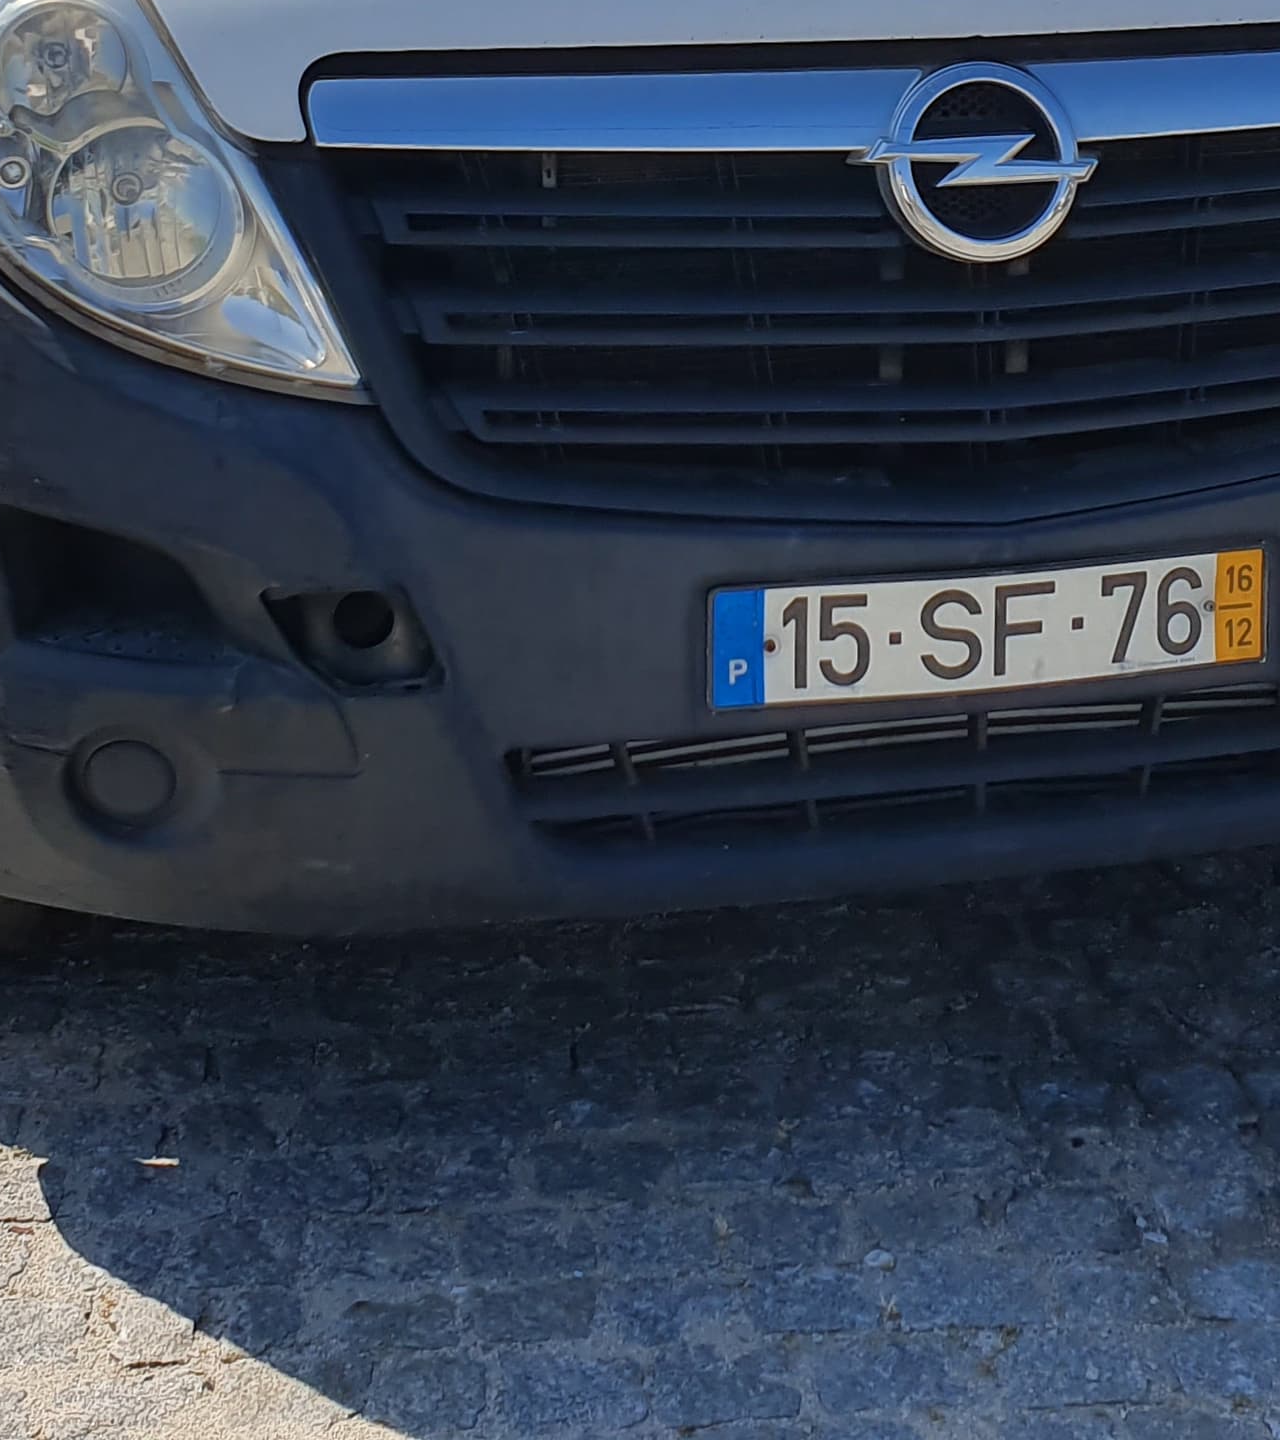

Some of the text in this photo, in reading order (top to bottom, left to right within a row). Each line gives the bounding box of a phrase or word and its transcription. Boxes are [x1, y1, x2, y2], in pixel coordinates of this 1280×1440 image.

[1226, 564, 1253, 594] 16
[1225, 617, 1253, 648] 12
[729, 659, 748, 685] P
